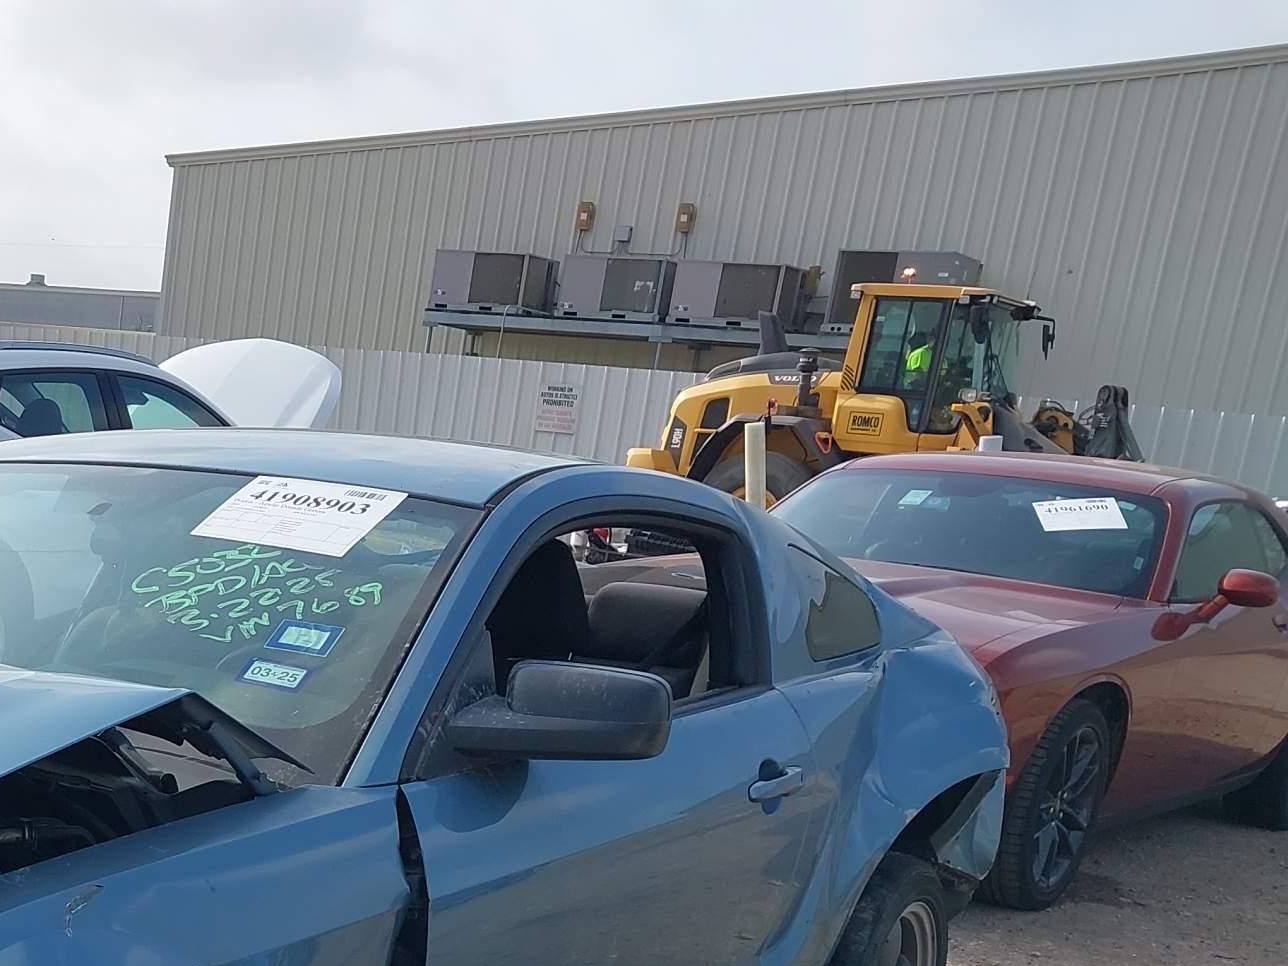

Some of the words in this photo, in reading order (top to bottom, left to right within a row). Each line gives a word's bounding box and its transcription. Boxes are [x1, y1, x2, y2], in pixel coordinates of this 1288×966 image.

[542, 399, 575, 407] PROHIBITED
[851, 415, 880, 428] ROMCO
[250, 489, 371, 515] 41908903
[1045, 504, 1109, 513] 41961690
